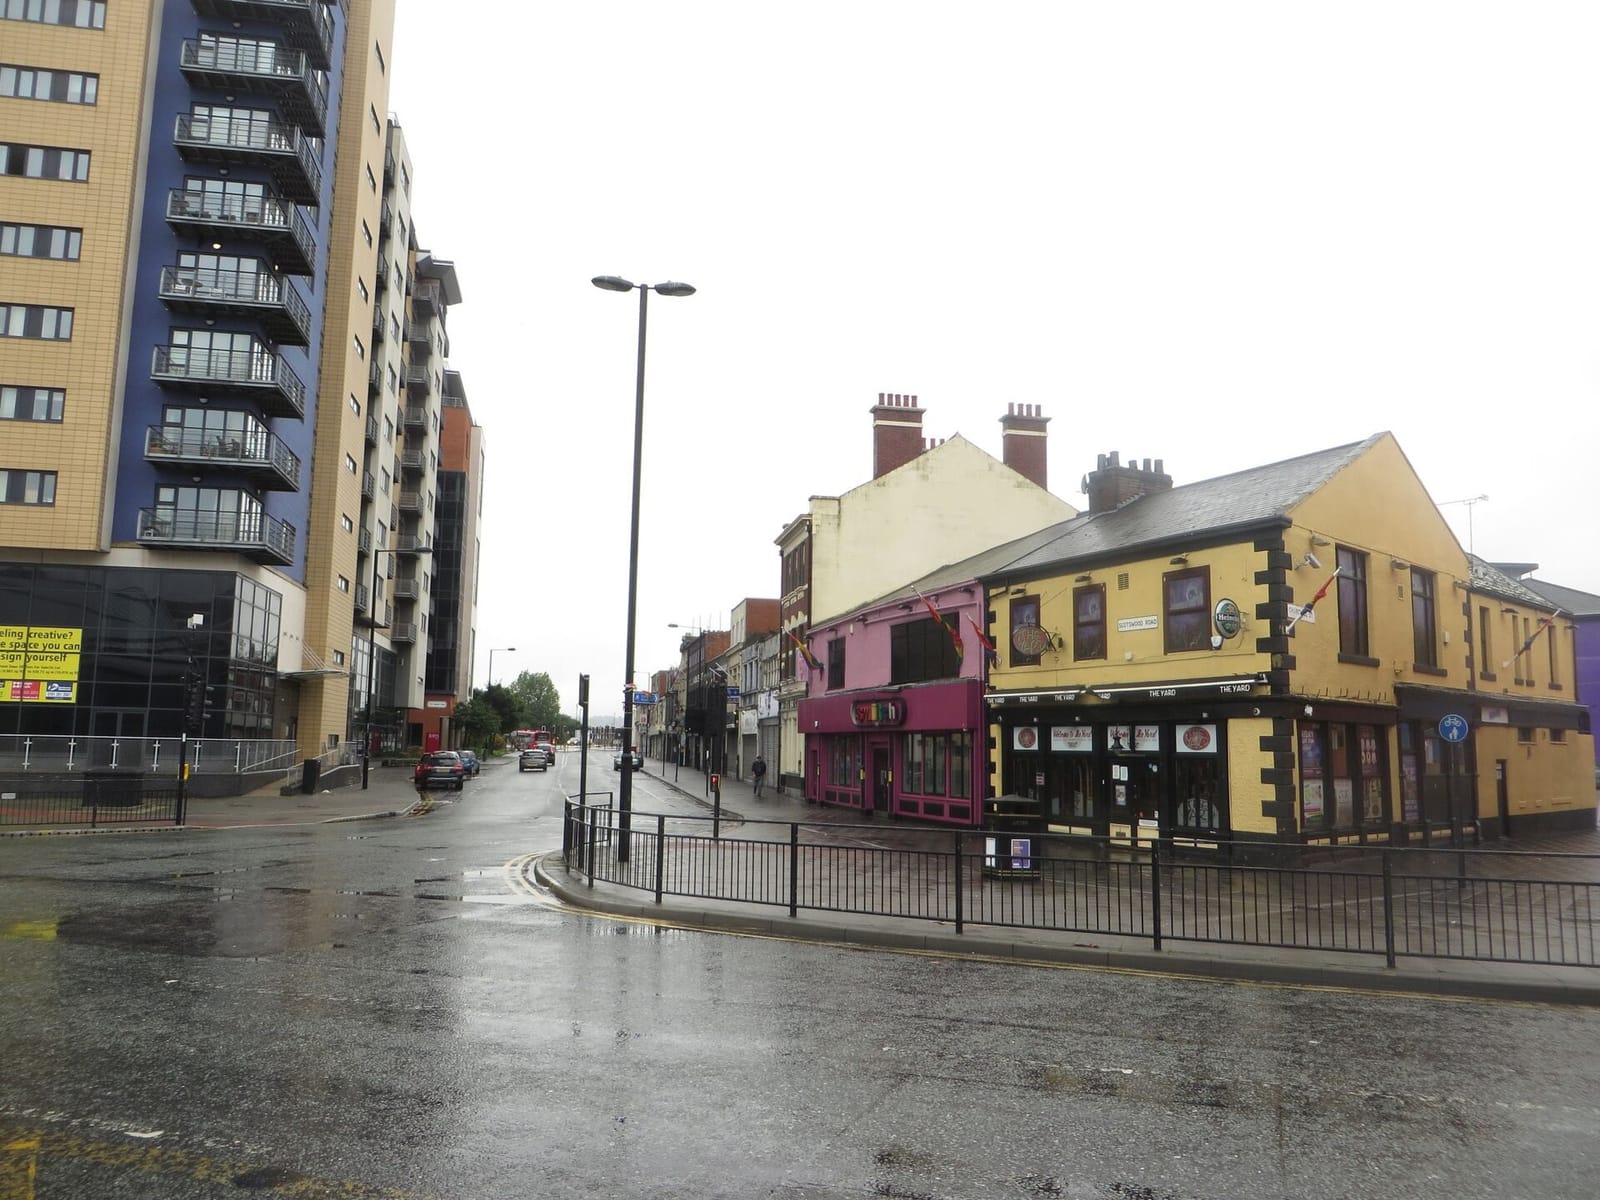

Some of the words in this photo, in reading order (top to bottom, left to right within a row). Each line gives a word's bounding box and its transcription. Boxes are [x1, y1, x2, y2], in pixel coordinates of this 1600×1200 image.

[29, 631, 73, 640] creative?
[9, 641, 40, 650] space
[42, 643, 60, 651] you
[63, 643, 80, 651] can
[26, 653, 67, 663] yourself
[1160, 688, 1176, 696] YARD
[1220, 685, 1232, 694] THE
[1232, 683, 1251, 693] YARD
